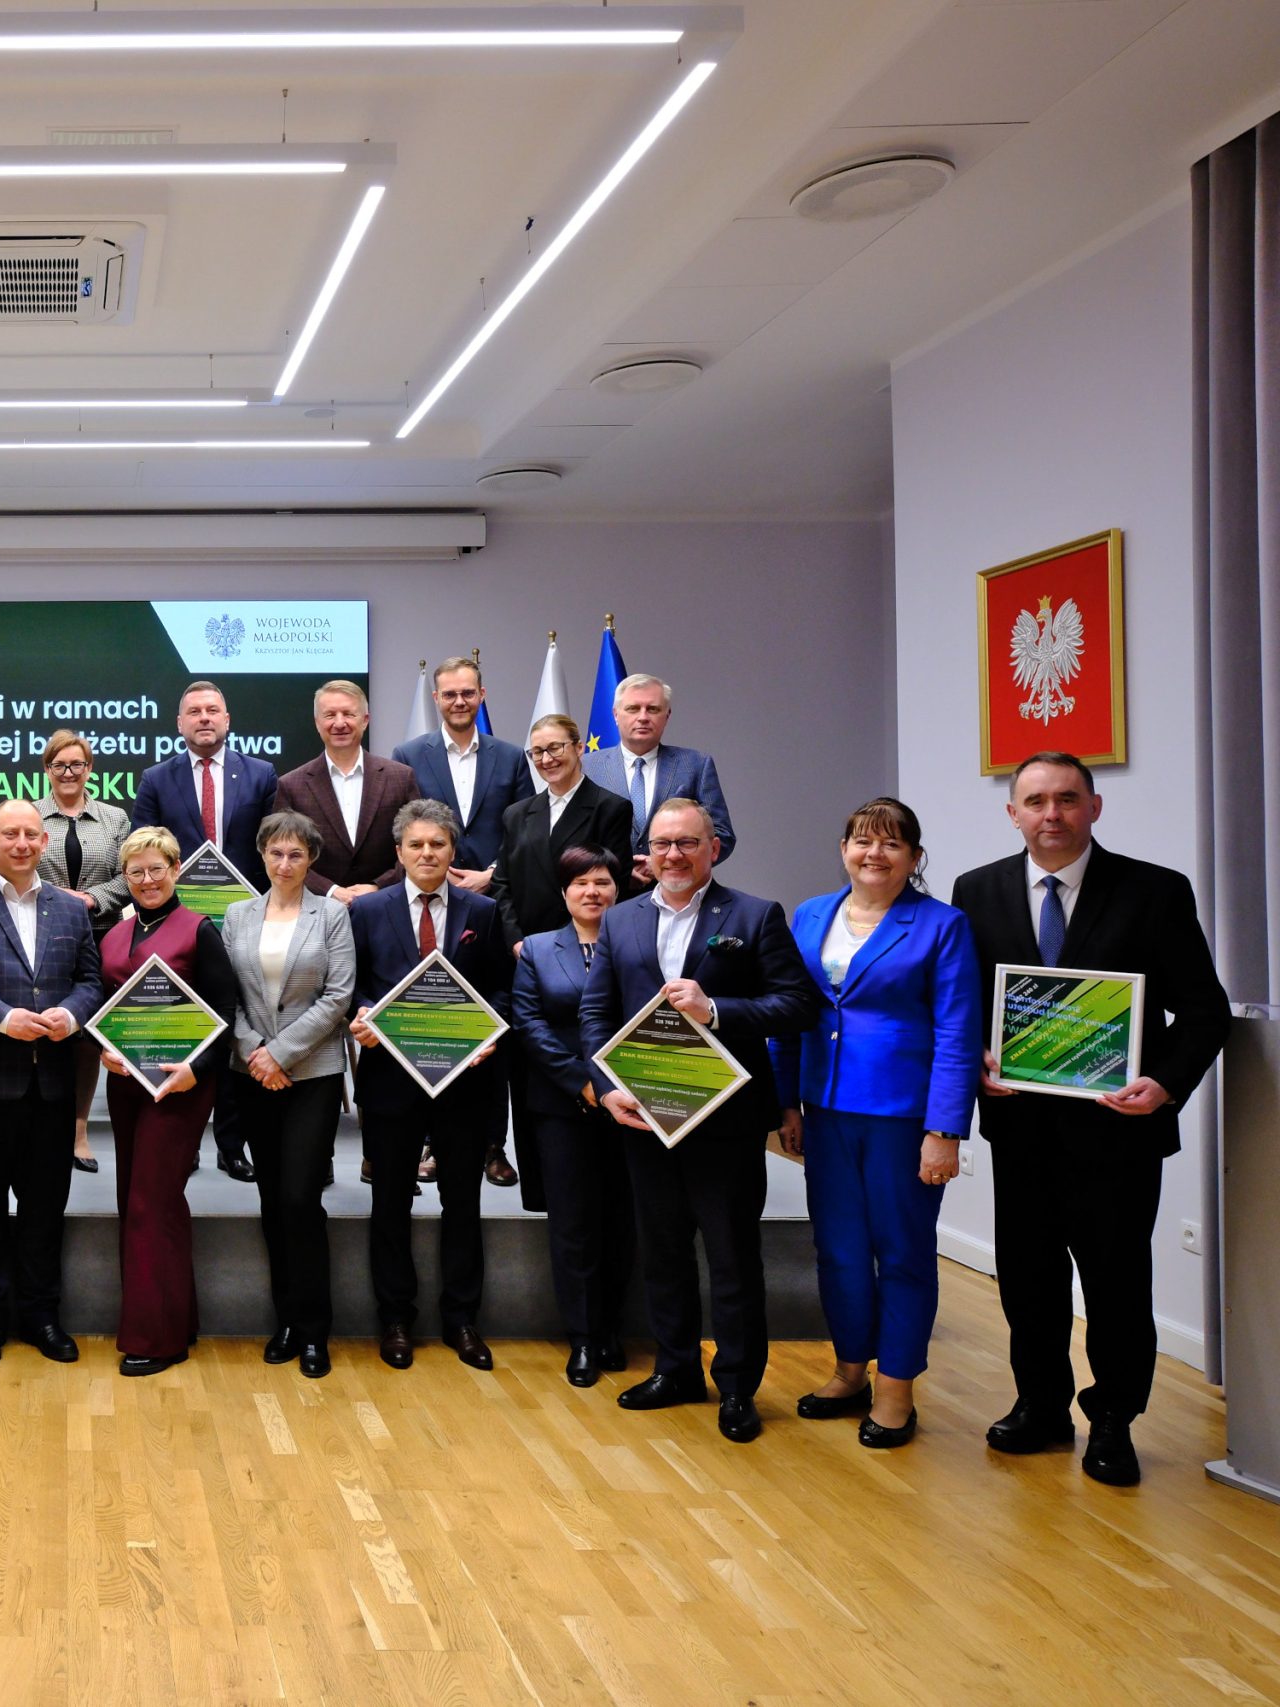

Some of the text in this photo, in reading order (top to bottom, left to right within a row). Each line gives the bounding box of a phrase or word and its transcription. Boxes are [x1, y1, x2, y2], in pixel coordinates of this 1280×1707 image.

[256, 618, 332, 630] WOJEWODA
[254, 632, 334, 642] MAŁOPOLSKI
[11, 701, 36, 720] w
[43, 696, 158, 720] ramach
[29, 731, 146, 754] bżetu
[156, 732, 282, 762] patwa
